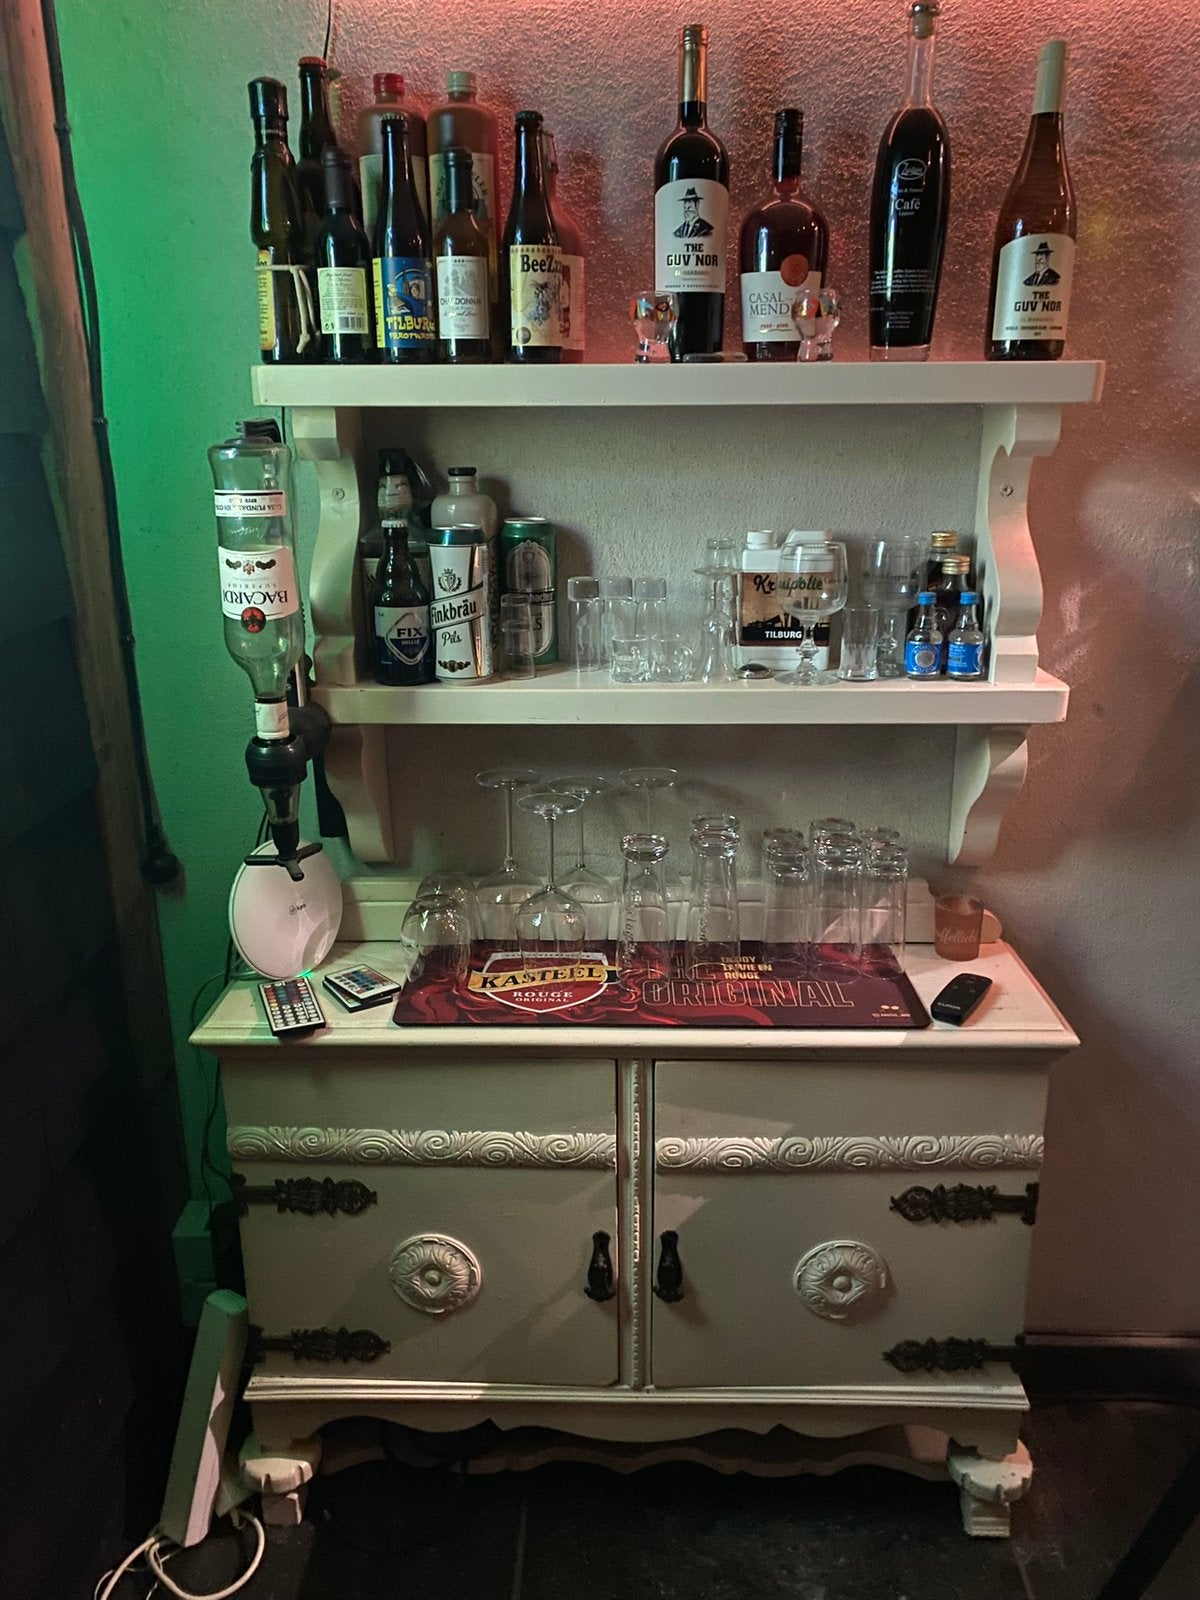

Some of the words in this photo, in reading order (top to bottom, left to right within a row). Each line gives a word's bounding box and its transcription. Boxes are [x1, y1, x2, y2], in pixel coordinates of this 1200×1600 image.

[895, 198, 921, 210] Café
[684, 243, 704, 252] THE
[667, 253, 718, 266] GUV'NOR
[749, 292, 785, 303] CASAL
[1032, 291, 1050, 300] THE
[749, 303, 790, 316] MEND
[1014, 300, 1062, 312] GUV'NOR
[397, 627, 422, 638] FIX
[441, 630, 463, 647] Pils
[764, 630, 803, 639] TILBURG
[480, 966, 602, 989] KASTEEL
[642, 980, 854, 1008] ORIGINAL
